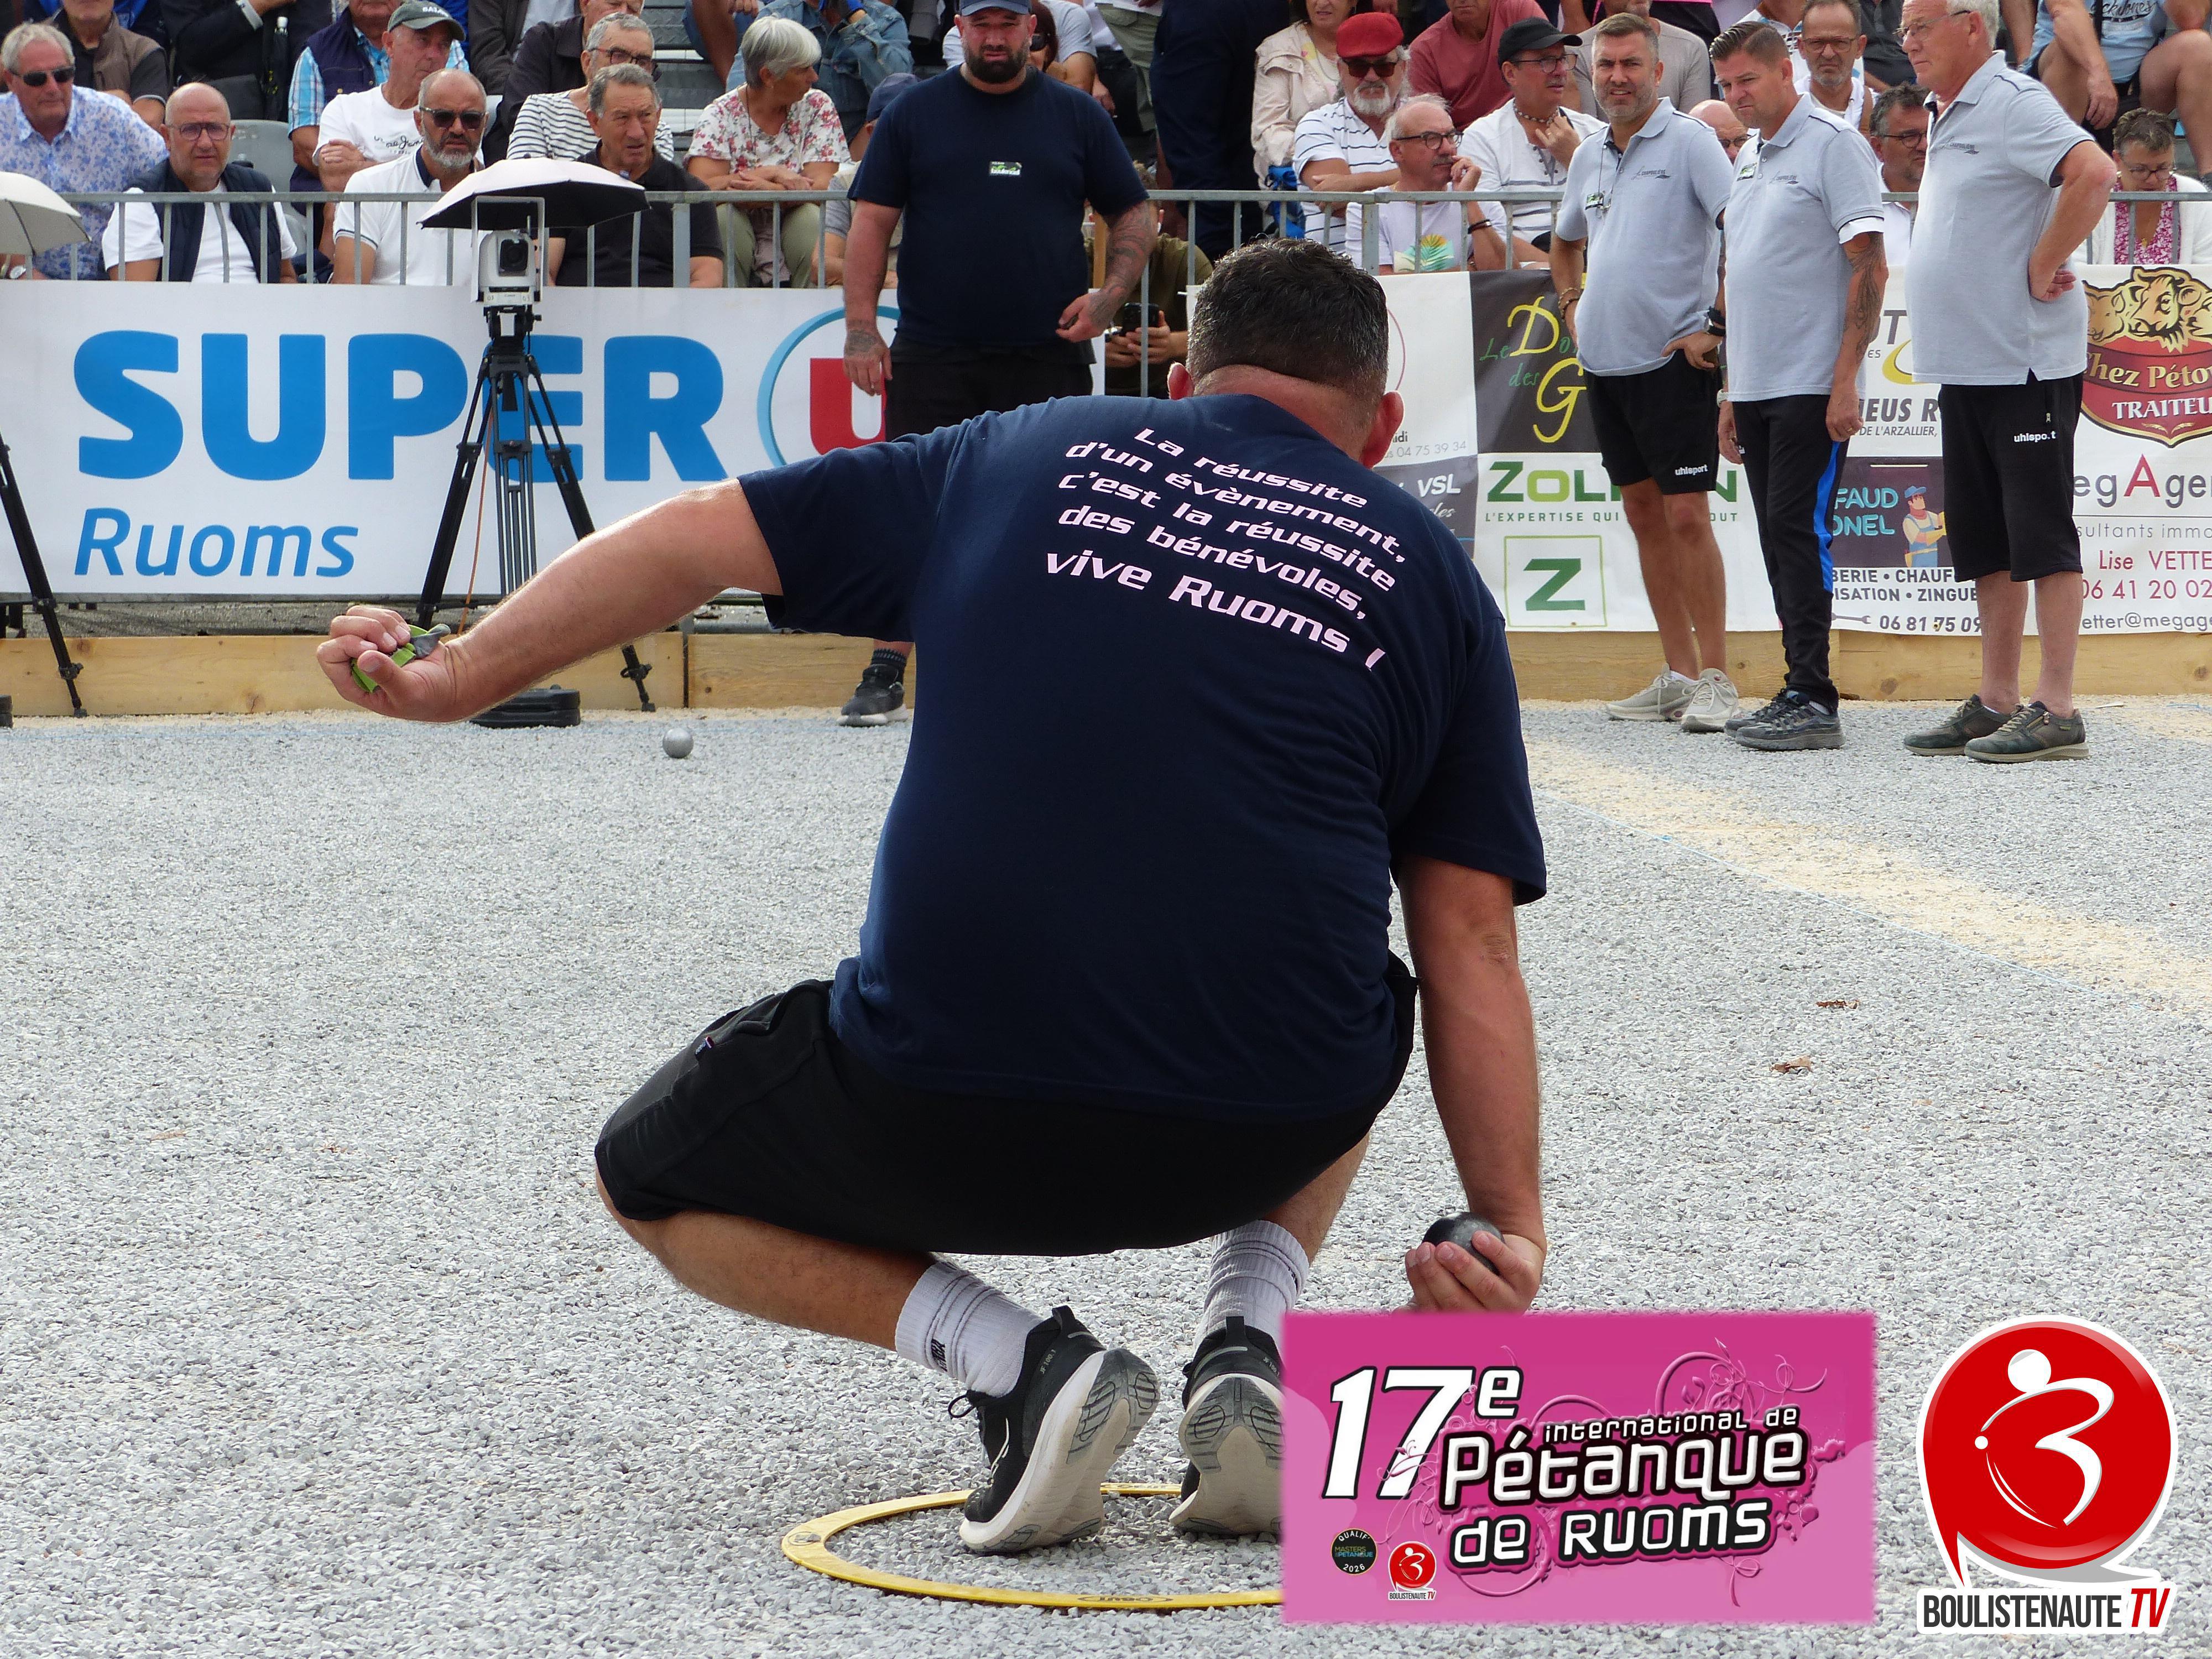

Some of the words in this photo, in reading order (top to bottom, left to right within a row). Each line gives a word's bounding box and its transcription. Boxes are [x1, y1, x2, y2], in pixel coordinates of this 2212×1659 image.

[1480, 338, 1511, 361] Le
[1507, 296, 1578, 357] Do
[1509, 362, 1540, 387] des
[2086, 352, 2141, 387] hez
[2147, 364, 2212, 389] Péto
[74, 330, 729, 482] SUPER
[1921, 398, 1938, 422] R
[2111, 396, 2212, 420] TRAITEU
[1860, 426, 1872, 436] DE
[1875, 426, 1937, 437] L'ARZALLIER,
[1397, 446, 1411, 458] 04
[1416, 445, 1430, 456] 75
[1434, 442, 1449, 454] 39
[1453, 440, 1467, 452] 34
[1134, 427, 1186, 457] La
[1193, 456, 1368, 508] réussite
[1674, 464, 1708, 476] uhlsport
[1417, 473, 1461, 498] VSL
[1487, 461, 1738, 502] ZOLN
[2074, 453, 2212, 508] egAge
[1065, 441, 1154, 473] d'un
[1165, 472, 1406, 563] évènement,
[1834, 486, 1900, 510] FAUD
[1485, 512, 1584, 522] L'EXPERTISE
[1593, 512, 1619, 522] QUI
[1708, 513, 1738, 521] OUT
[1832, 513, 1896, 537] ONEL
[74, 507, 359, 578] Ruoms
[1057, 471, 1162, 509] c'est
[1172, 502, 1213, 526] la
[1225, 520, 1396, 592] réussite
[2077, 523, 2153, 538] sultants
[2161, 523, 2212, 539] immo
[1057, 505, 1136, 535] des
[1146, 525, 1366, 621] bénévoles,
[2099, 549, 2134, 570] Lise
[2148, 550, 2212, 571] VETTE
[1832, 568, 1878, 583] BERIE
[1895, 568, 1953, 583] CHAUF
[1835, 587, 1900, 602] ISATION
[1917, 588, 1978, 602] ZINGUE
[2111, 579, 2137, 599] 41
[2148, 579, 2177, 599] 20
[2185, 579, 2212, 598] 02
[1046, 549, 1153, 591] vive
[1167, 575, 1351, 654] Ruoms
[1879, 615, 1901, 630] 06
[1906, 616, 1927, 632] 81
[1933, 616, 1956, 632] 75
[2081, 612, 2212, 632] etter@megag
